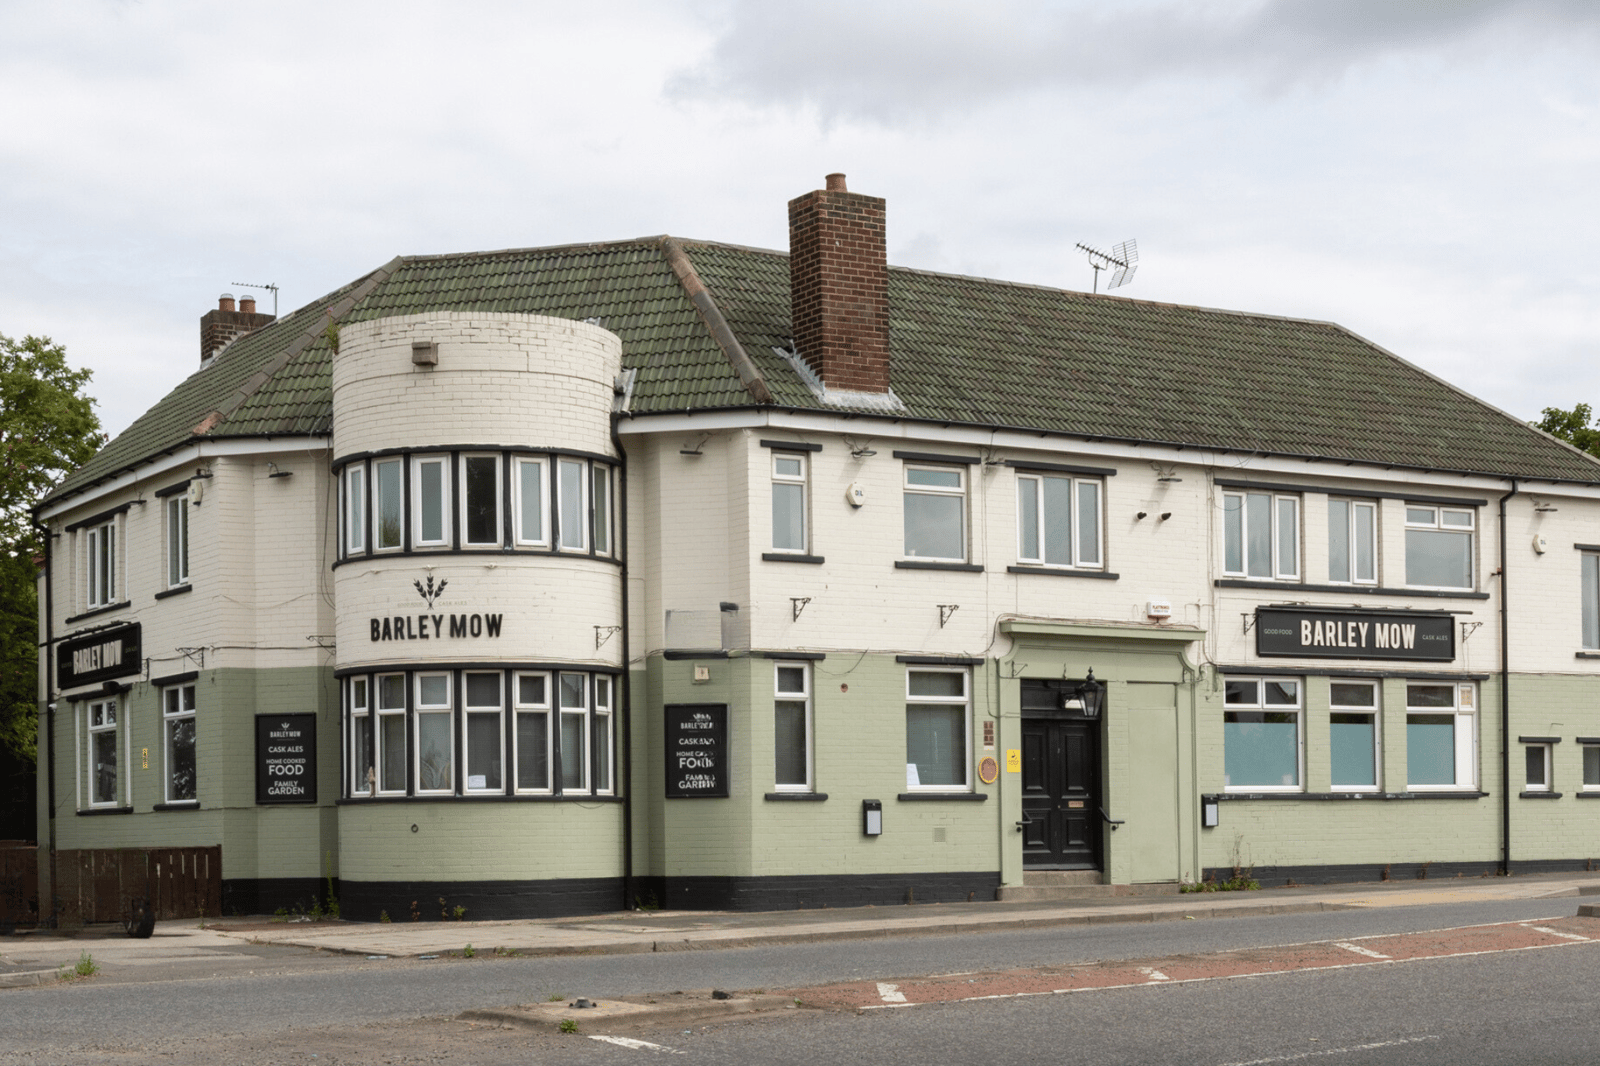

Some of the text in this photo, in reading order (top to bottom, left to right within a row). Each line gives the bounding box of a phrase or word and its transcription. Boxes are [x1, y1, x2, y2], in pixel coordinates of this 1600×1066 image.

[370, 613, 503, 642] BARLEY MOW
[1300, 620, 1416, 650] BARLEY MOW
[73, 644, 102, 675] BARLEY
[268, 764, 304, 775] FOOD
[268, 786, 304, 795] GARDEN
